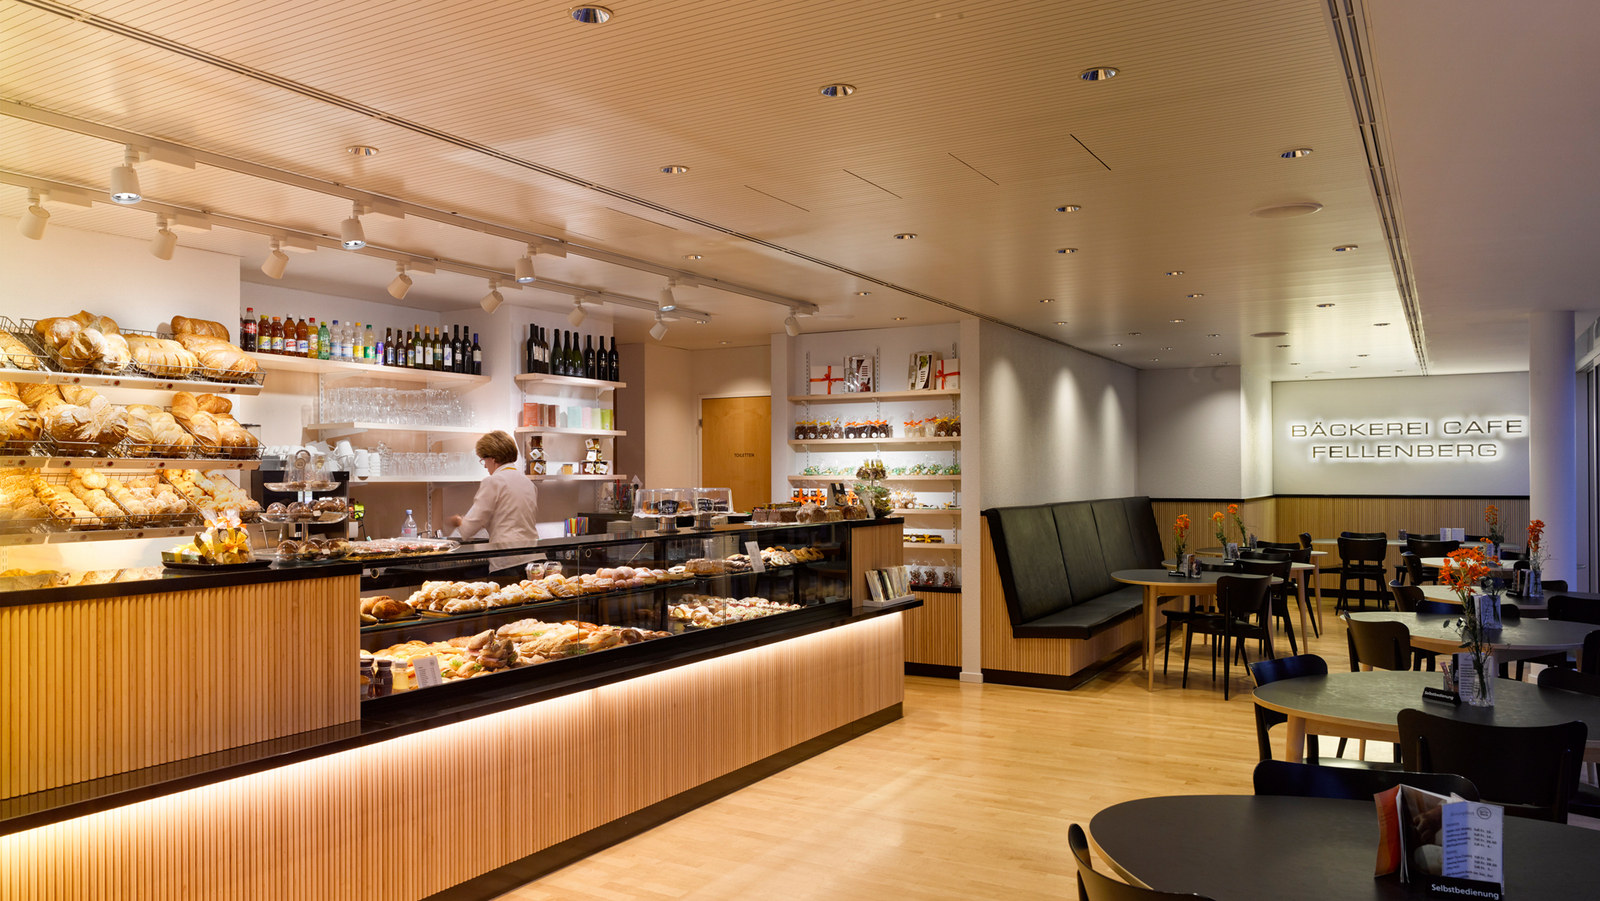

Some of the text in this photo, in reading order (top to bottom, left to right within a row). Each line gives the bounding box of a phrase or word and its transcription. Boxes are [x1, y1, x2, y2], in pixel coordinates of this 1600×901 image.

[1291, 419, 1523, 438] BÄCKEREI CAFE
[1312, 443, 1498, 459] FELLENBERG
[1431, 883, 1500, 900] Selbstbedienung
